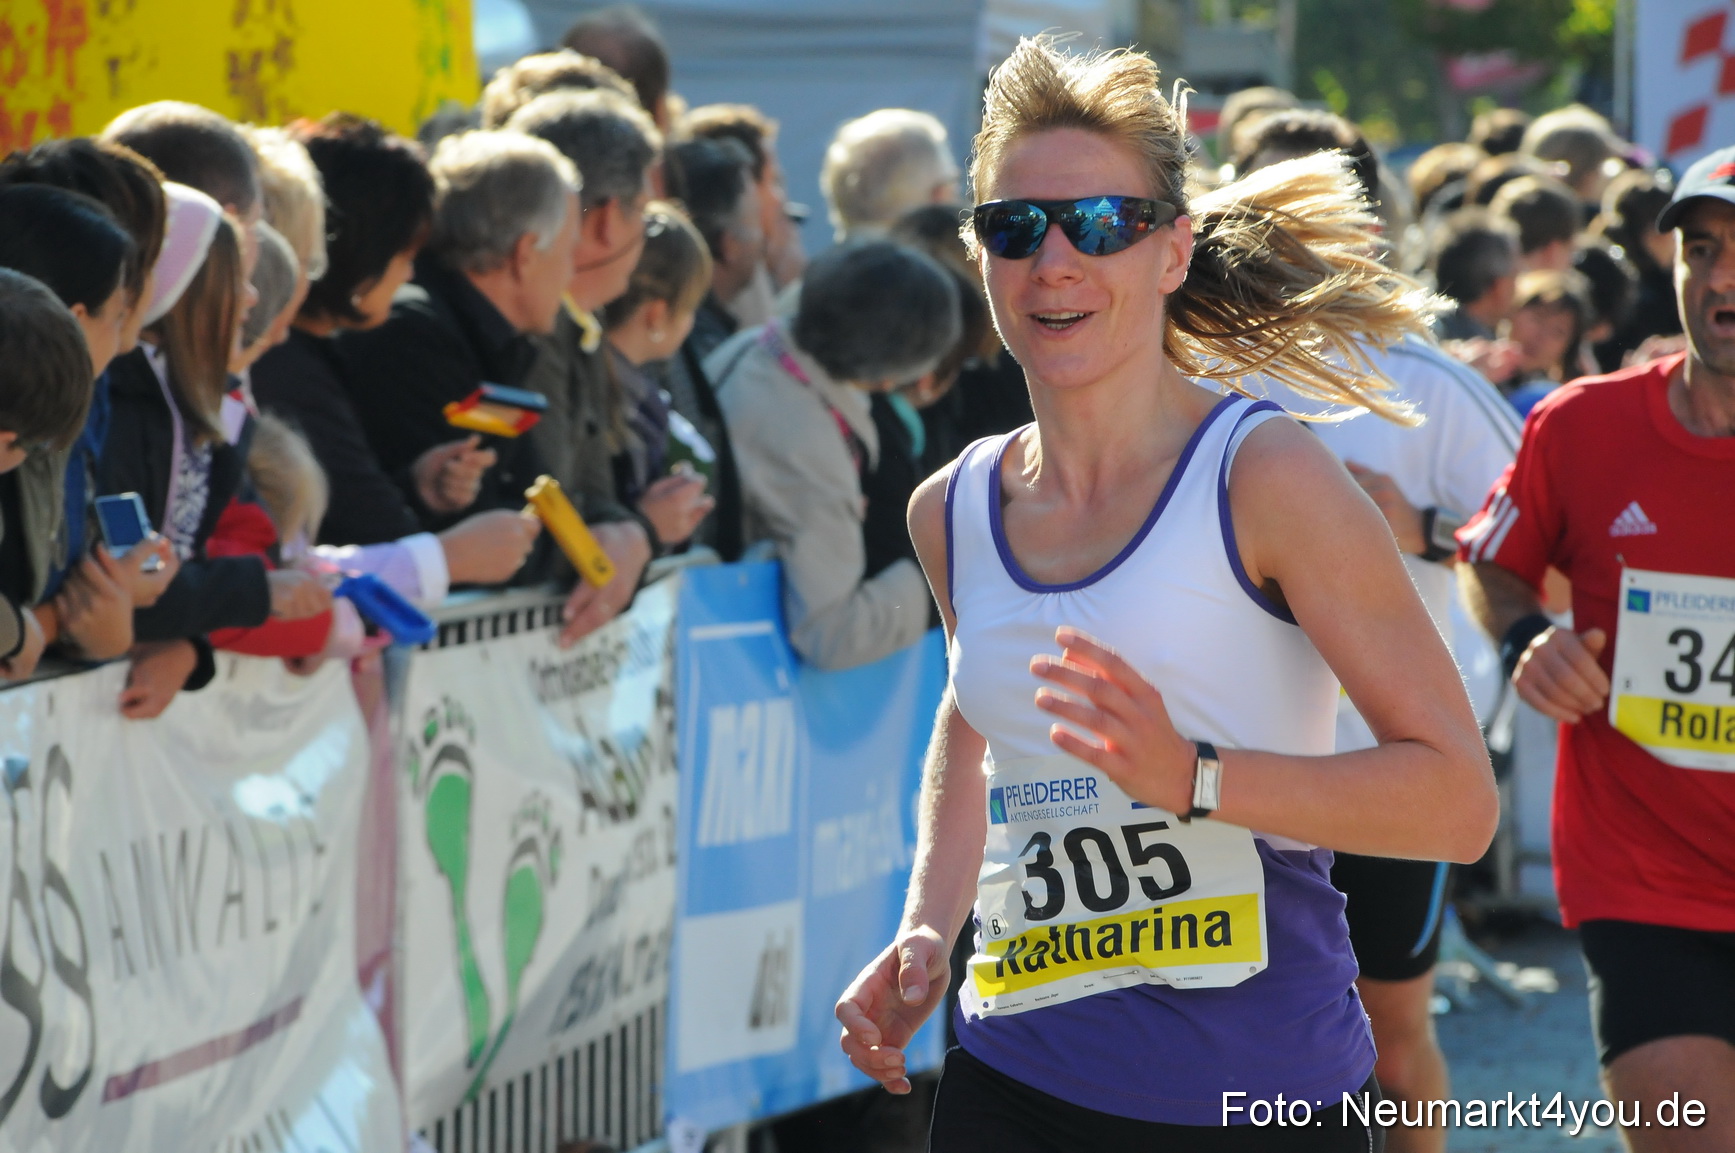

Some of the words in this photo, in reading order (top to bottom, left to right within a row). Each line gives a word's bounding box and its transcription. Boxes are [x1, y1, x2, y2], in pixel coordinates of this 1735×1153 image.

[1005, 776, 1099, 808] PFLEIDERER
[1009, 803, 1100, 823] AKTIENGESELLSCHAFT
[1017, 821, 1192, 921] 305
[991, 919, 1001, 936] B
[995, 907, 1232, 978] Katharina
